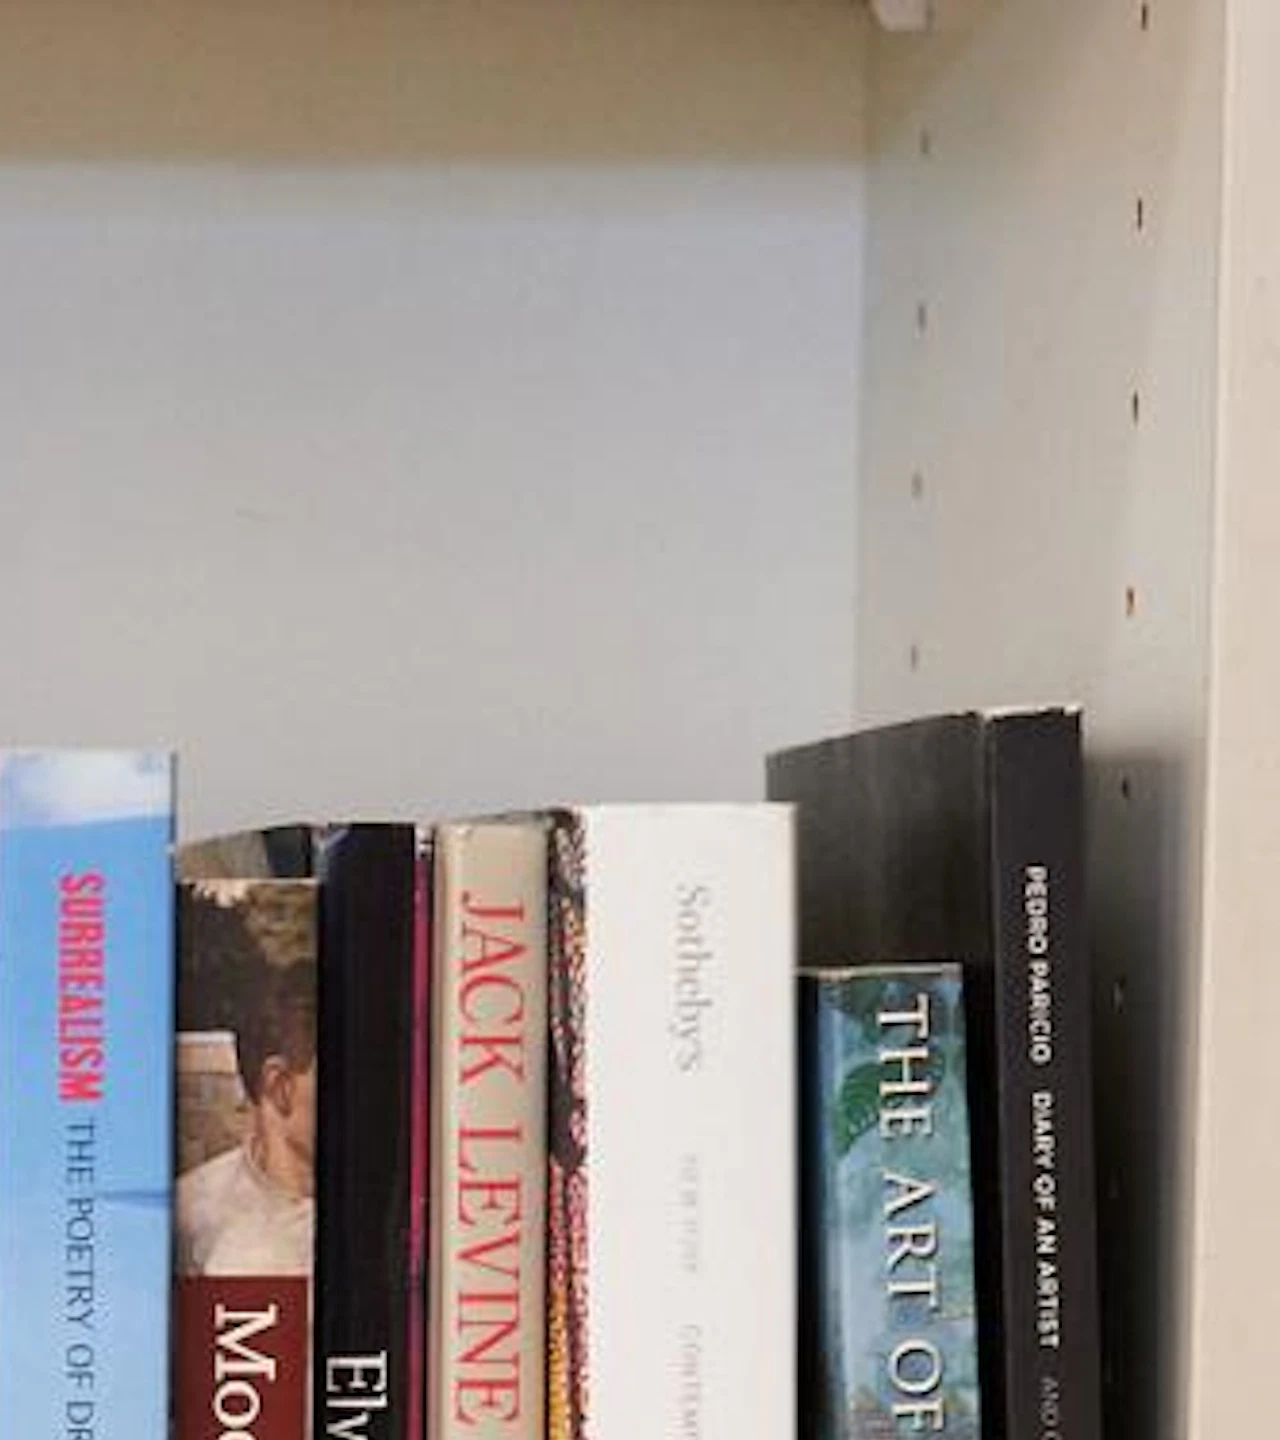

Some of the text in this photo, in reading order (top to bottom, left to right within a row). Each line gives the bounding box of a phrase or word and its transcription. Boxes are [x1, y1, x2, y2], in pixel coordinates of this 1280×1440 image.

[1024, 865, 1052, 953] PEDRO
[58, 873, 107, 1102] SURREALISM
[878, 992, 937, 1139] THE
[66, 1121, 97, 1190] THE
[454, 891, 527, 1427] JACK LEVINE
[1032, 1091, 1063, 1350] DIARY OF AN ARTIST
[65, 1199, 96, 1328] POETRY
[882, 1171, 940, 1307] ART
[65, 1344, 96, 1389] OF
[887, 1339, 944, 1433] OF
